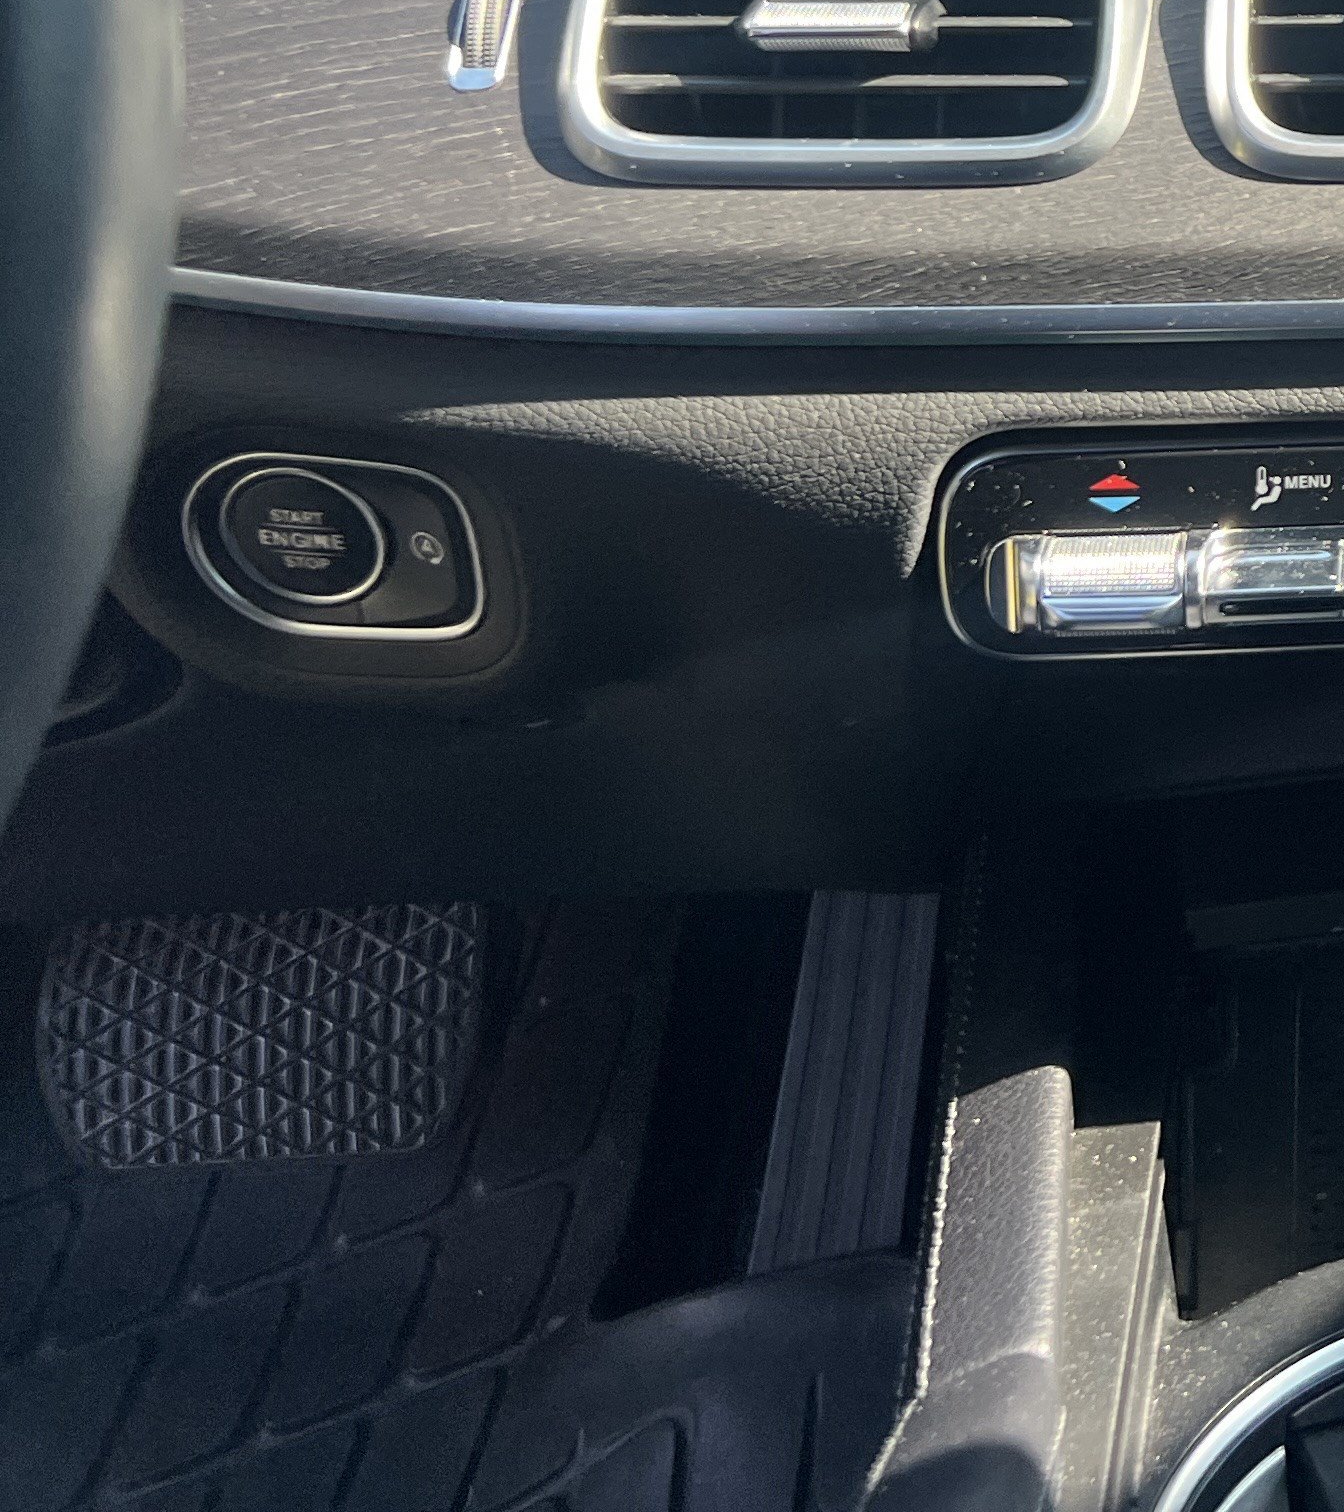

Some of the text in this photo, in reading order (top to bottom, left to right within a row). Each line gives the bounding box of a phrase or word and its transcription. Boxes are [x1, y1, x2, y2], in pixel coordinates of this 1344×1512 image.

[1284, 474, 1332, 489] MENU
[269, 508, 325, 523] START
[258, 528, 348, 551] ENGINE
